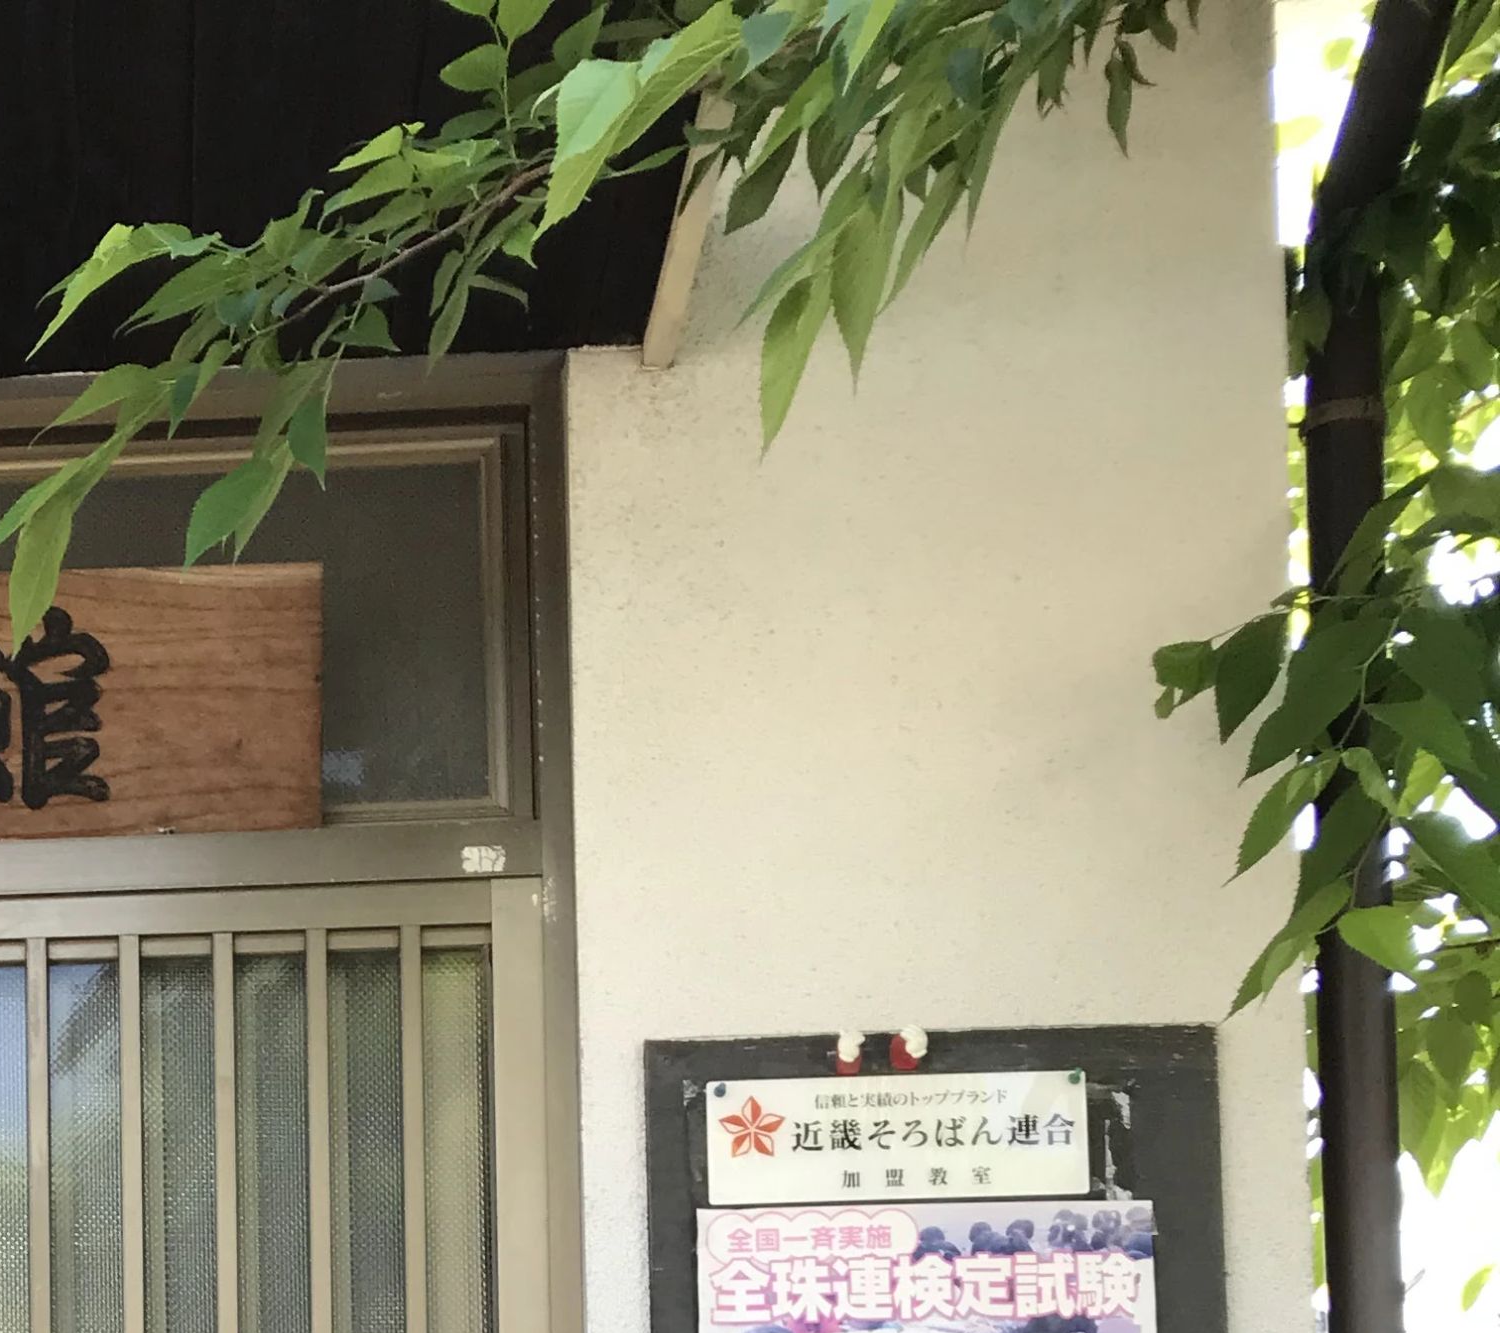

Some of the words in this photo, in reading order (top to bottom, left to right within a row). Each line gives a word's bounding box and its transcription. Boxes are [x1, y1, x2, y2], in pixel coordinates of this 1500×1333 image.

[814, 1089, 1009, 1111] 信頼と実績のトップブランド
[792, 1113, 1076, 1153] 近畿そろばん連合
[841, 1166, 993, 1189] 加盟教室
[727, 1225, 892, 1254] 全国一斉実施
[709, 1251, 1142, 1326] 全珠連検定試験
